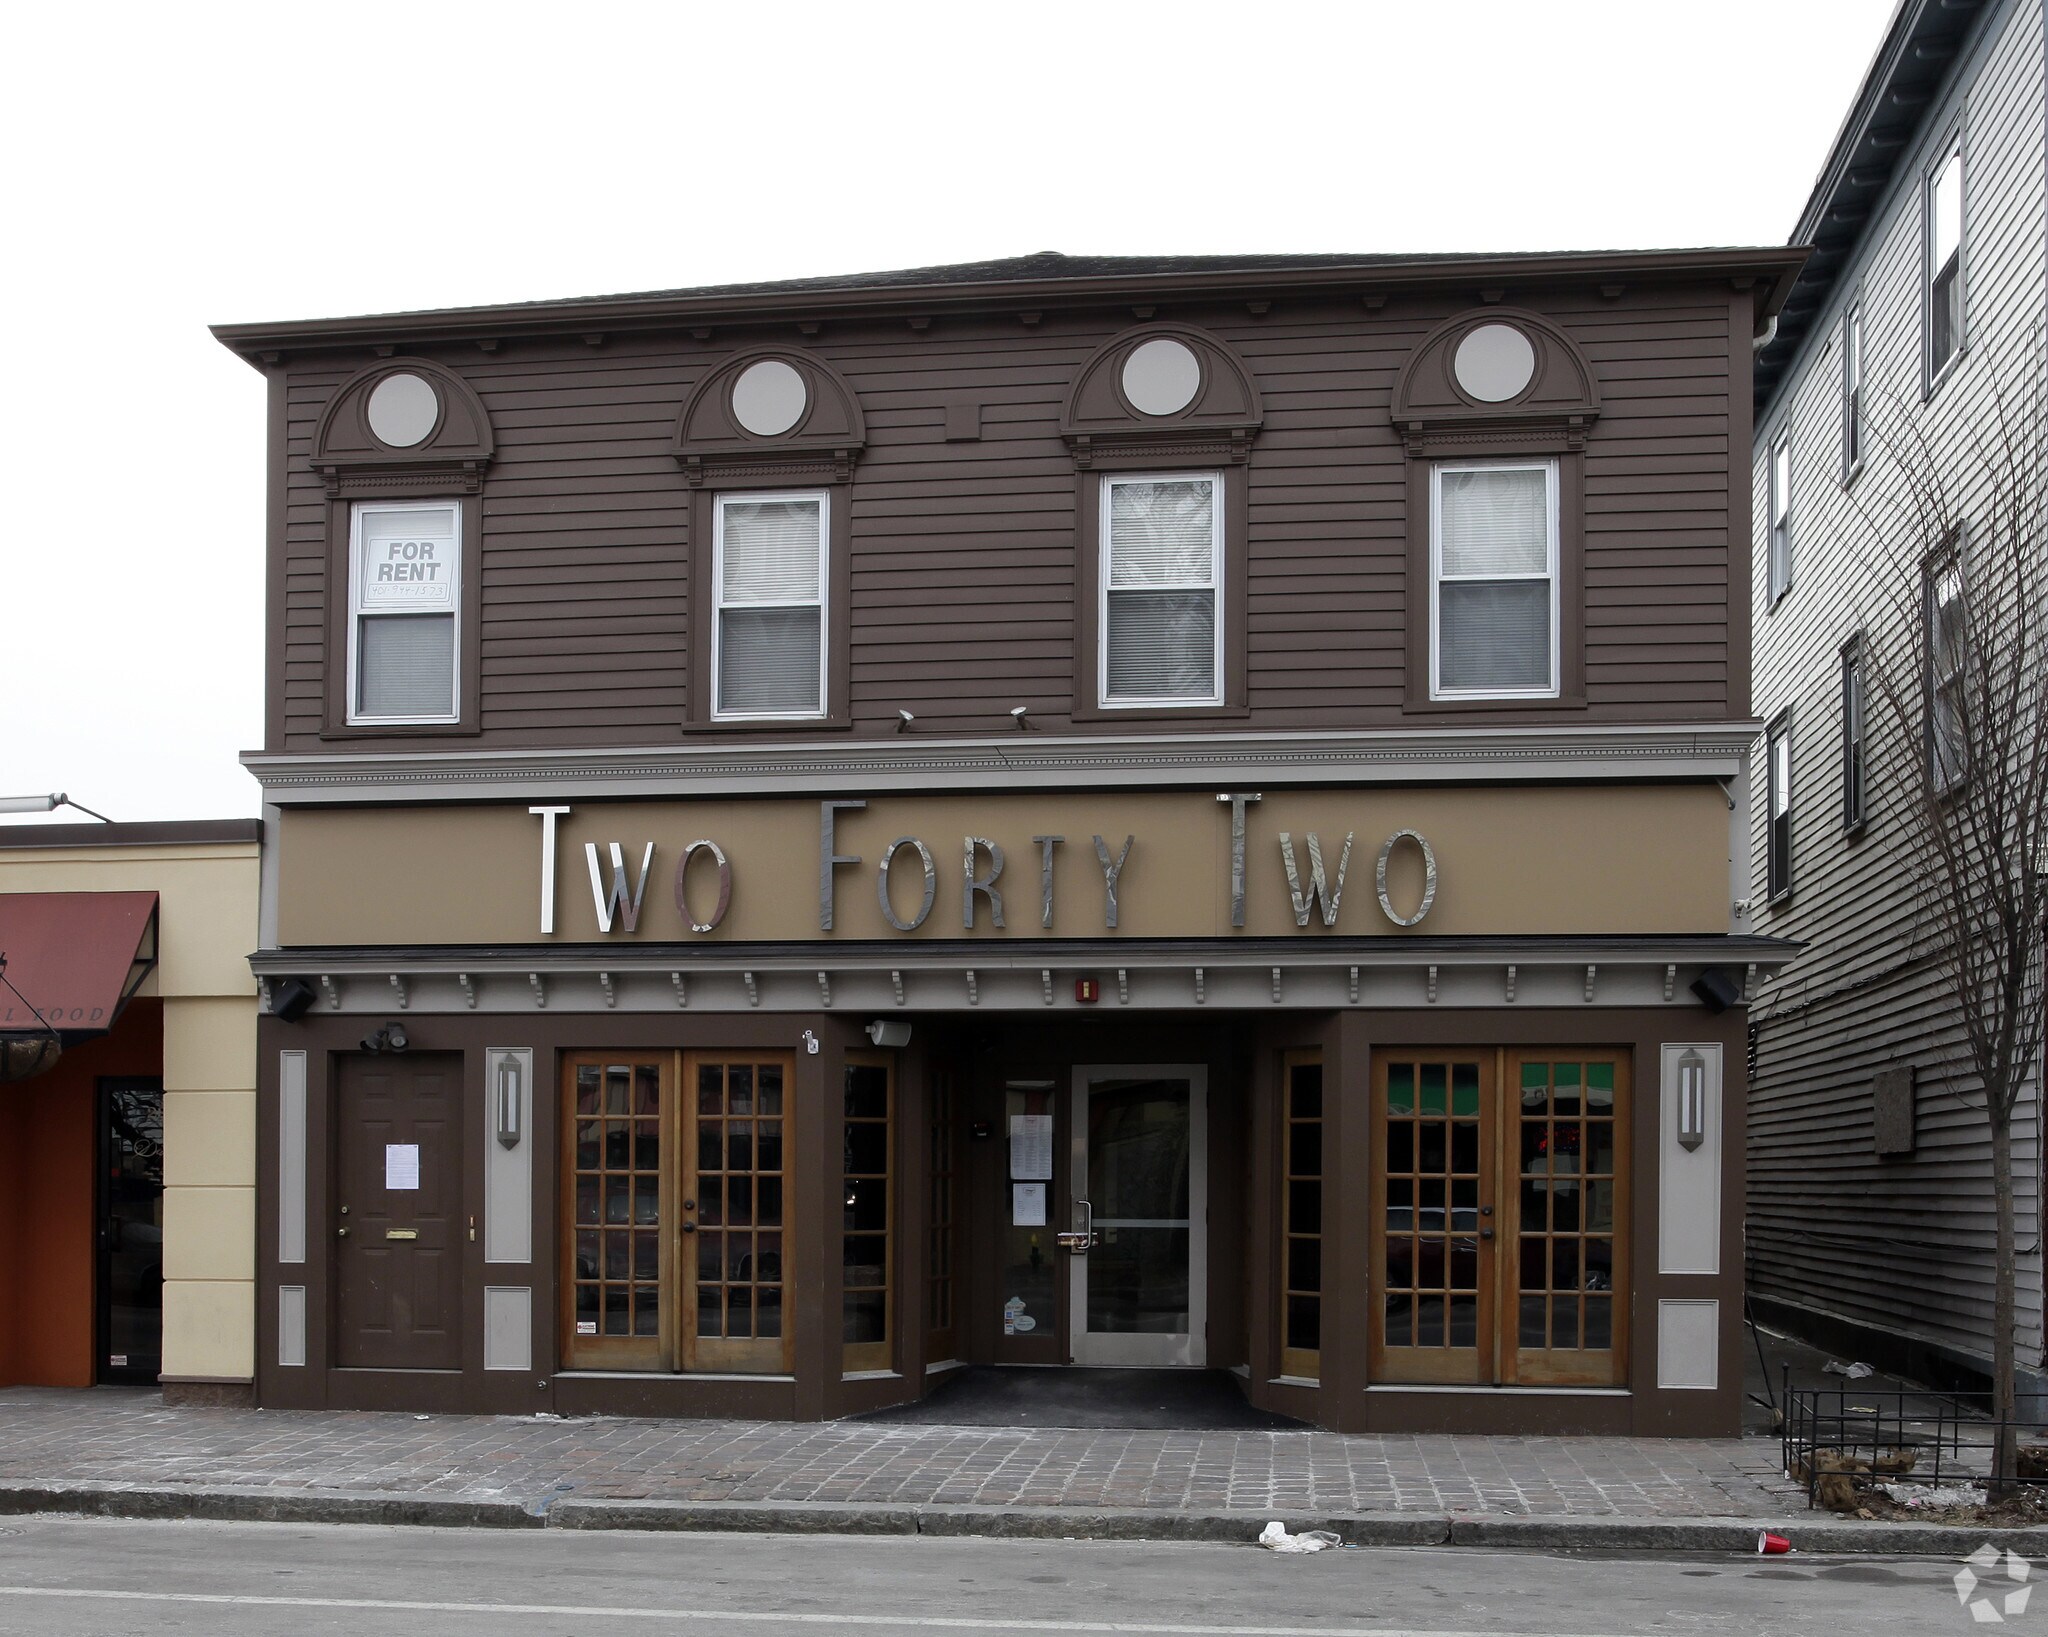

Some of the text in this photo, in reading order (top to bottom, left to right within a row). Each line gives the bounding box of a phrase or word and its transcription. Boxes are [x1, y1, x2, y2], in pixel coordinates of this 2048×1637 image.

[388, 542, 435, 560] FOR
[378, 563, 441, 581] RENT
[33, 1007, 104, 1021] FOOD
